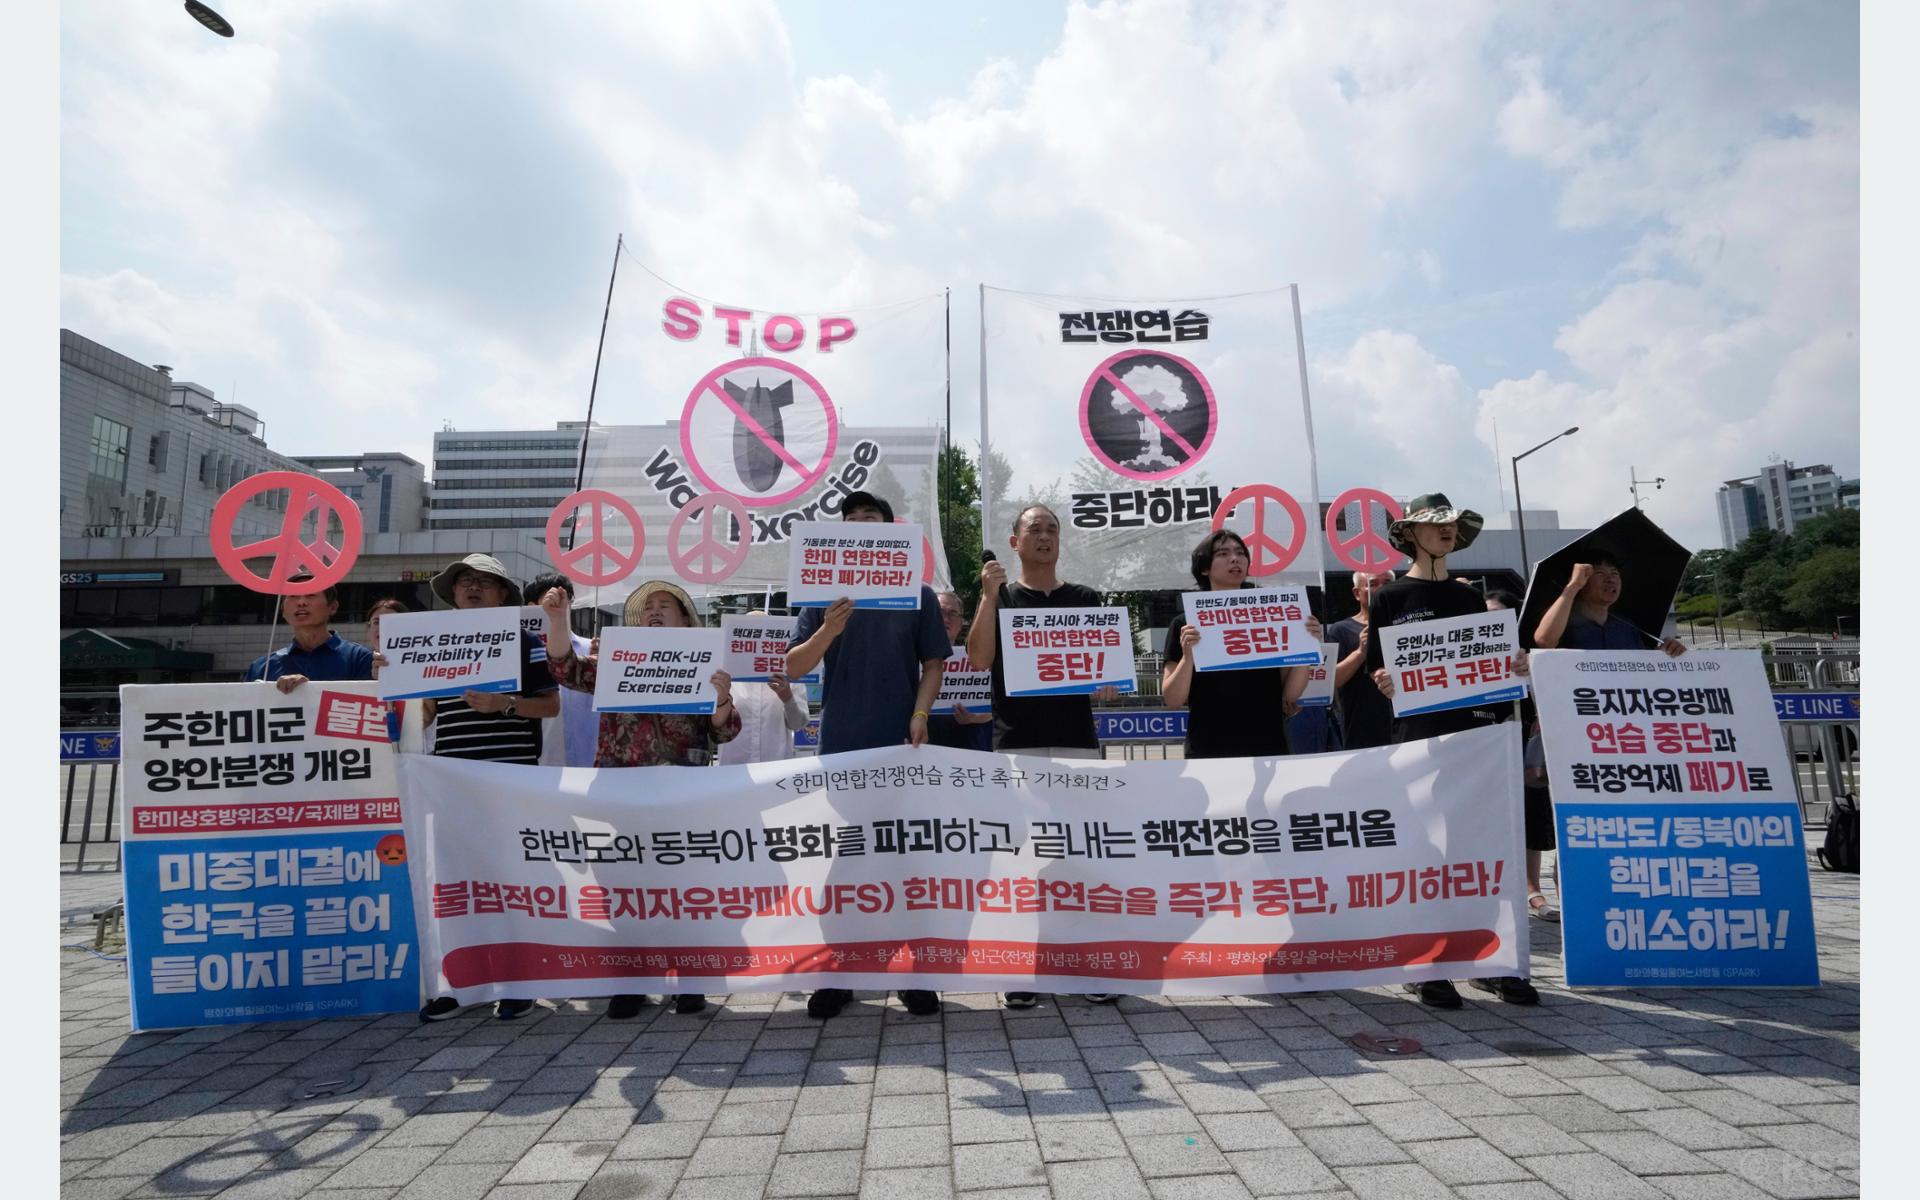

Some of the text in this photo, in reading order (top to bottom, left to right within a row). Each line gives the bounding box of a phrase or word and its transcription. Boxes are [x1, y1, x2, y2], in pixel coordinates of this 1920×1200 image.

[663, 298, 856, 353] STOP
[1059, 309, 1210, 343] 전쟁연습
[802, 538, 911, 549] 기동훈련 분산 시행 의미없다.
[804, 549, 908, 567] 한미 연합연습
[60, 573, 93, 584] GS25
[801, 569, 912, 587] 전면 폐기하라!
[1196, 593, 1299, 609] 한반도/동북아 평화 파괴
[1012, 613, 1120, 629] 중국, 러시아 겨냥한
[1196, 605, 1302, 627] 한미연합연습
[387, 630, 516, 649] USFK Strategic
[731, 640, 757, 653] 한미
[733, 628, 762, 639] 핵대결
[1012, 629, 1120, 648] 한미연합연습
[1222, 626, 1289, 656] 중단!
[1396, 623, 1504, 652] 유엔사를 대중 작전
[401, 647, 502, 665] Flexibility Is
[611, 651, 712, 665] Stop ROK-US
[1037, 652, 1105, 681] 중단!
[1394, 642, 1512, 668] 수행기구로 강화하려는
[1575, 661, 1721, 672] <한미연합전쟁연습 반대 1인 시위>
[423, 663, 473, 679] Illegal
[624, 666, 698, 678] Combined
[944, 675, 990, 686] tended
[1401, 656, 1512, 693] 미국 규탄!
[617, 681, 693, 694] Exercises
[1573, 688, 1734, 716] 을지자유방패
[1802, 699, 1844, 715] LINE
[143, 707, 306, 749] 주한미군
[1108, 718, 1174, 734] POLICE
[1586, 722, 1736, 754] 연습 중단과
[144, 748, 371, 792] 양안분쟁 개입
[792, 765, 943, 794] 한미연합전쟁연습
[949, 767, 985, 788] 중단
[990, 768, 1029, 789] 촉구
[1034, 771, 1109, 790] 기자회견
[1571, 761, 1773, 793] 확장억제 폐기로
[137, 802, 399, 829] 한미상호방위조약/국제법 위반
[519, 809, 1397, 865] 한반도와 동북아 평화를 파괴하고, 끝내는 핵전쟁을 불러올
[1566, 815, 1795, 849] 한반도/동북아의
[158, 846, 381, 892] 미중대결에
[1609, 855, 1761, 898] 핵대결을
[432, 860, 1505, 920] 불법적인 을지자유방패(UFS) 한미연합연습을 즉각 중단, 폐기하라!
[161, 894, 391, 945] 한국을 끌어
[1604, 907, 1790, 951] 해소하라!
[151, 944, 410, 995] 들이지 말라!
[558, 954, 587, 968] 일시
[599, 954, 643, 967] 2025년
[646, 954, 669, 969] 8월
[674, 954, 727, 969] 18일(월)
[732, 954, 761, 968] 오전
[765, 952, 795, 966] 11시
[831, 951, 863, 963] 장소
[876, 949, 904, 964] 용산
[908, 947, 968, 965] 대통령실
[1086, 955, 1116, 970] 정문
[1119, 951, 1141, 970] 앞)
[1181, 951, 1212, 965] 주최
